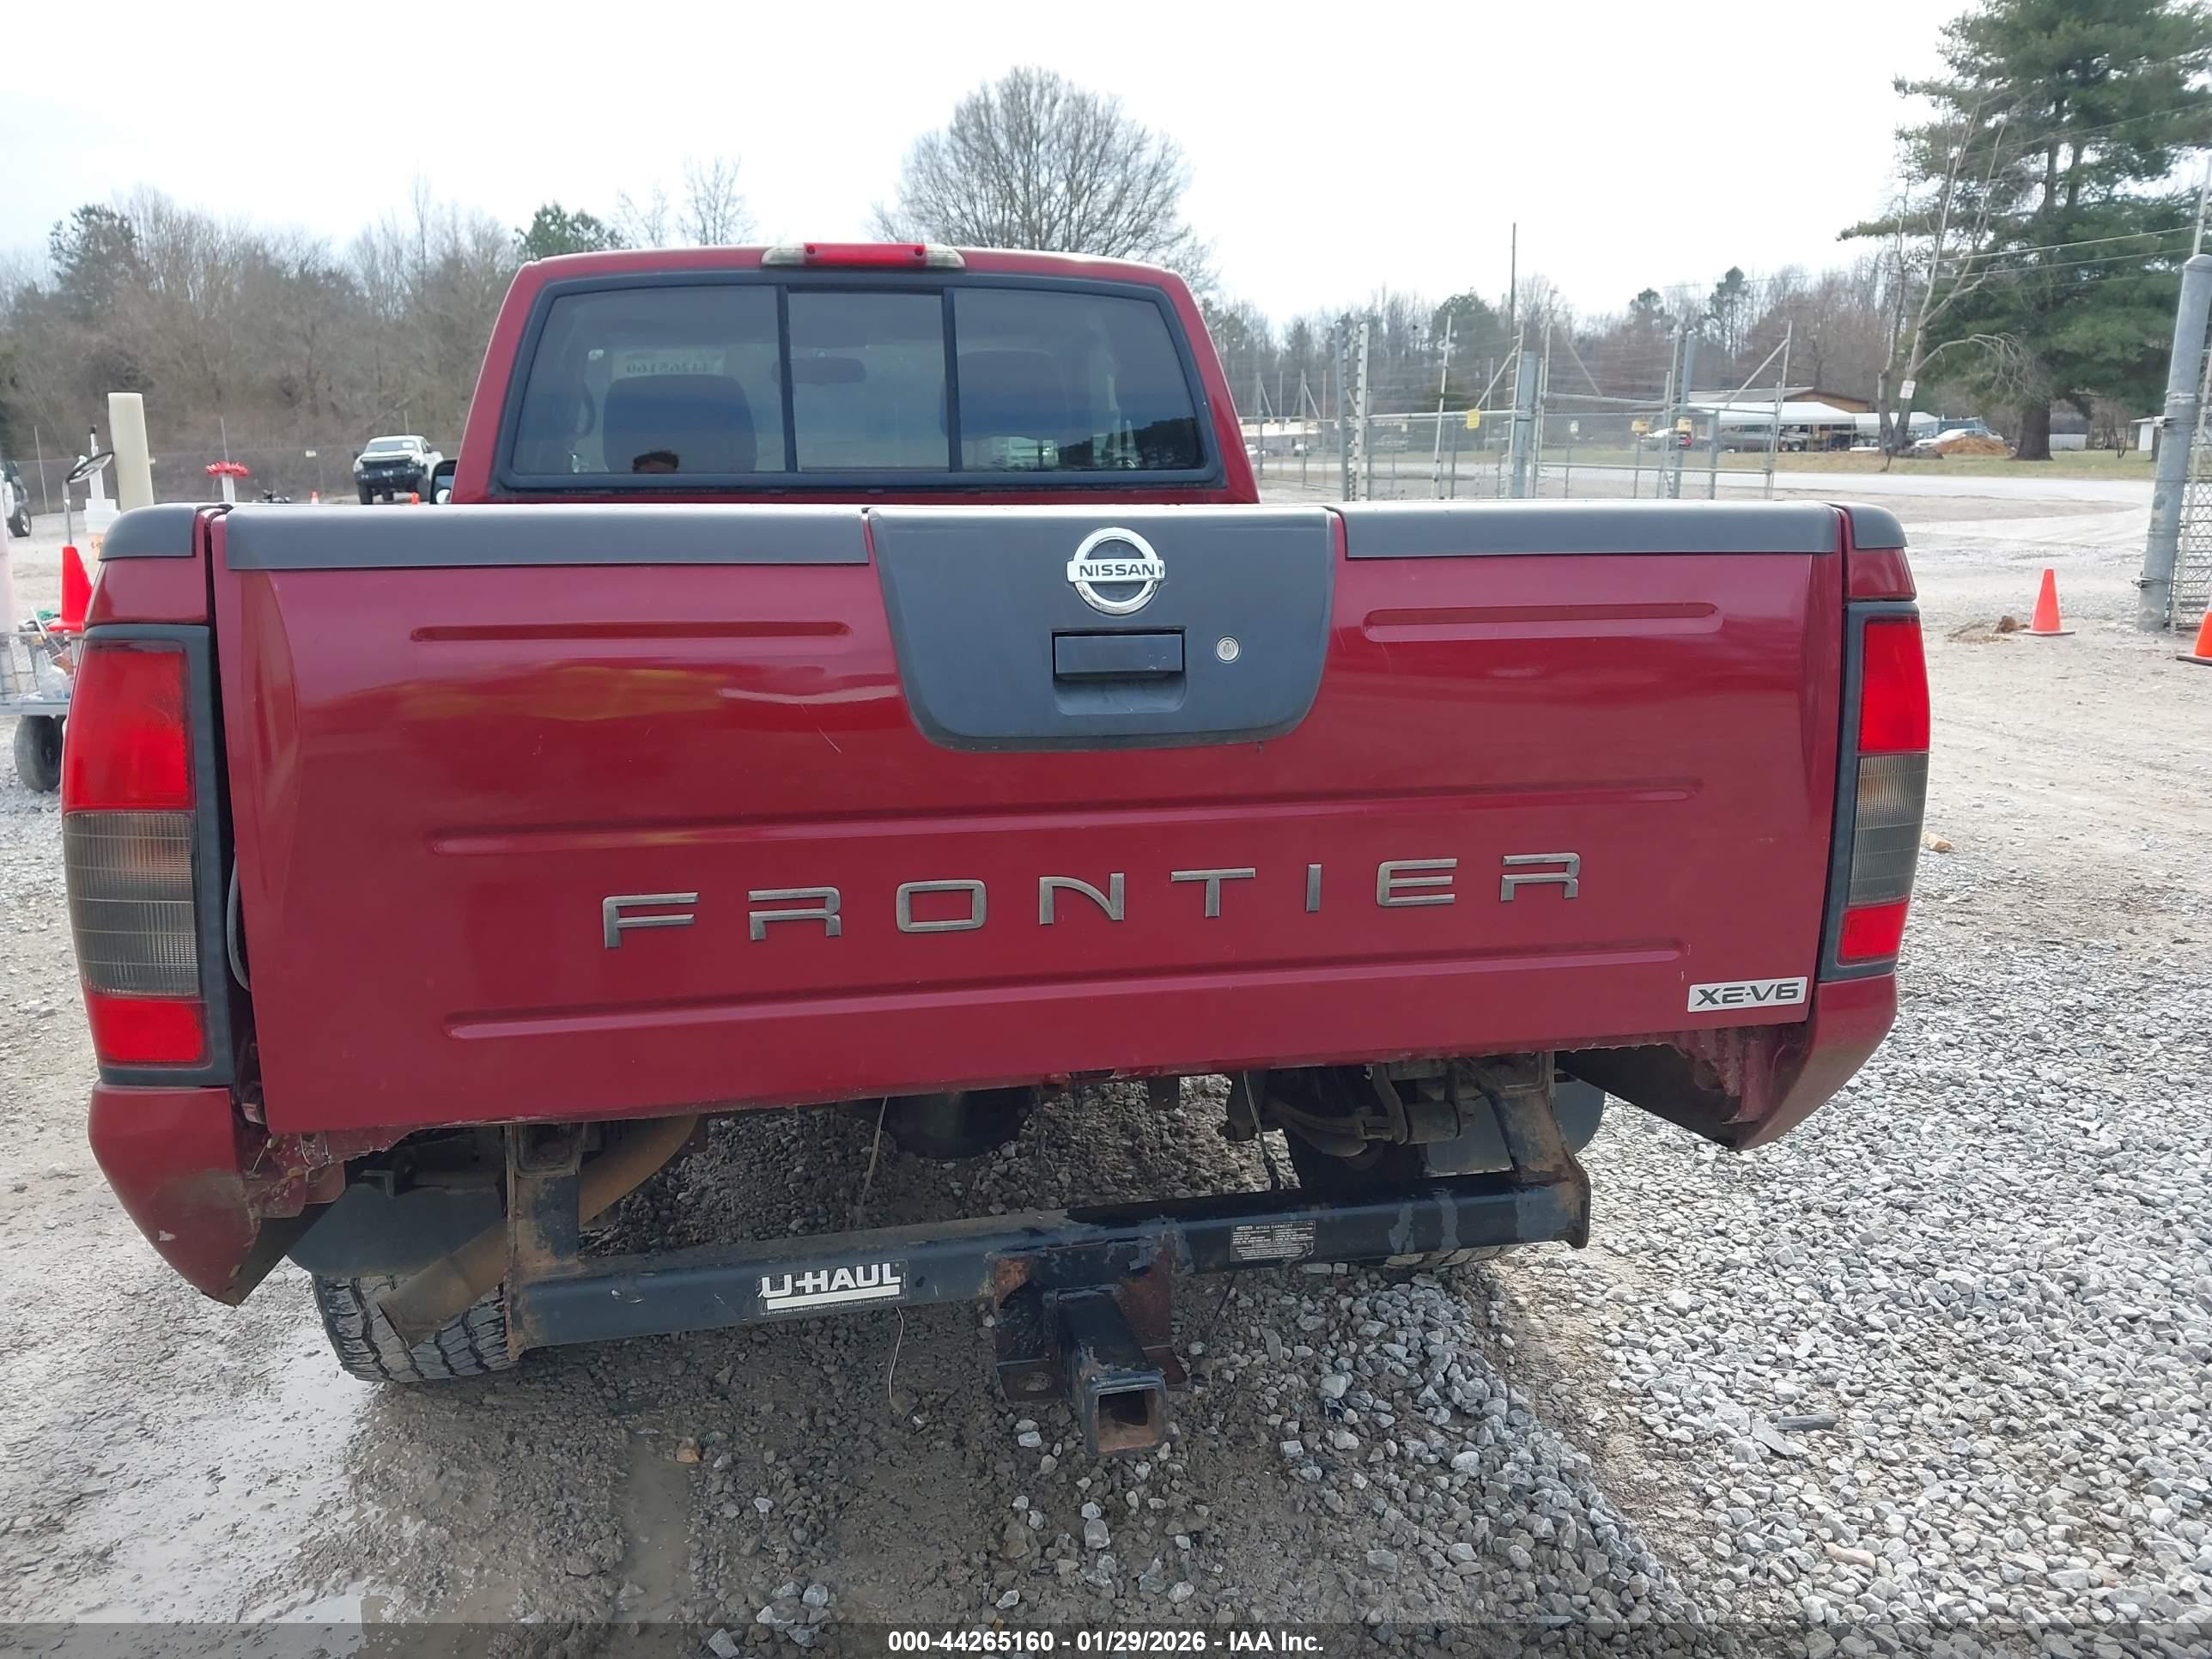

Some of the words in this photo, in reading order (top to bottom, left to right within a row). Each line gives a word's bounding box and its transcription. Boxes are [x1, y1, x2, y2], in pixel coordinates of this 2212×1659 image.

[1079, 563, 1156, 578] NISSAN
[602, 852, 1581, 949] FRONTIER
[1694, 981, 1800, 1006] XE-V6
[757, 1262, 902, 1299] U-HAUL
